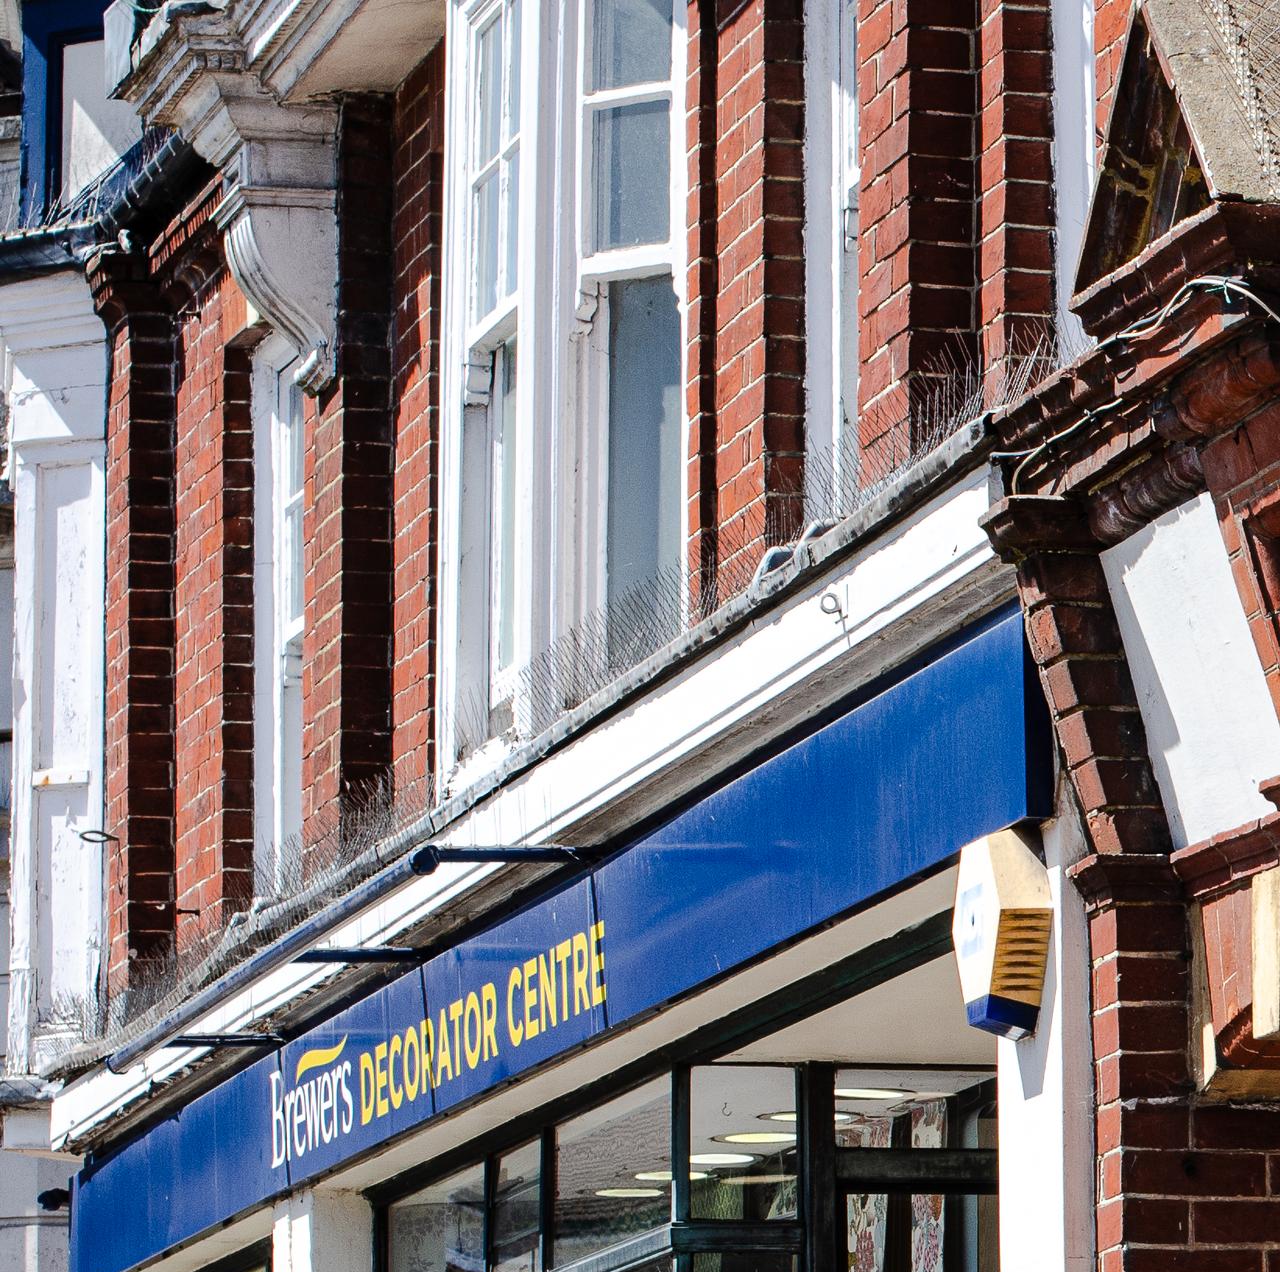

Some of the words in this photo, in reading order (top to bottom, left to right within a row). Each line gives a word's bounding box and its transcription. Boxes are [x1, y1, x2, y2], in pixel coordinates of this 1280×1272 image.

[271, 1060, 353, 1169] Brewers
[360, 982, 499, 1126] DECORATOR
[506, 921, 607, 1048] CENTRE
